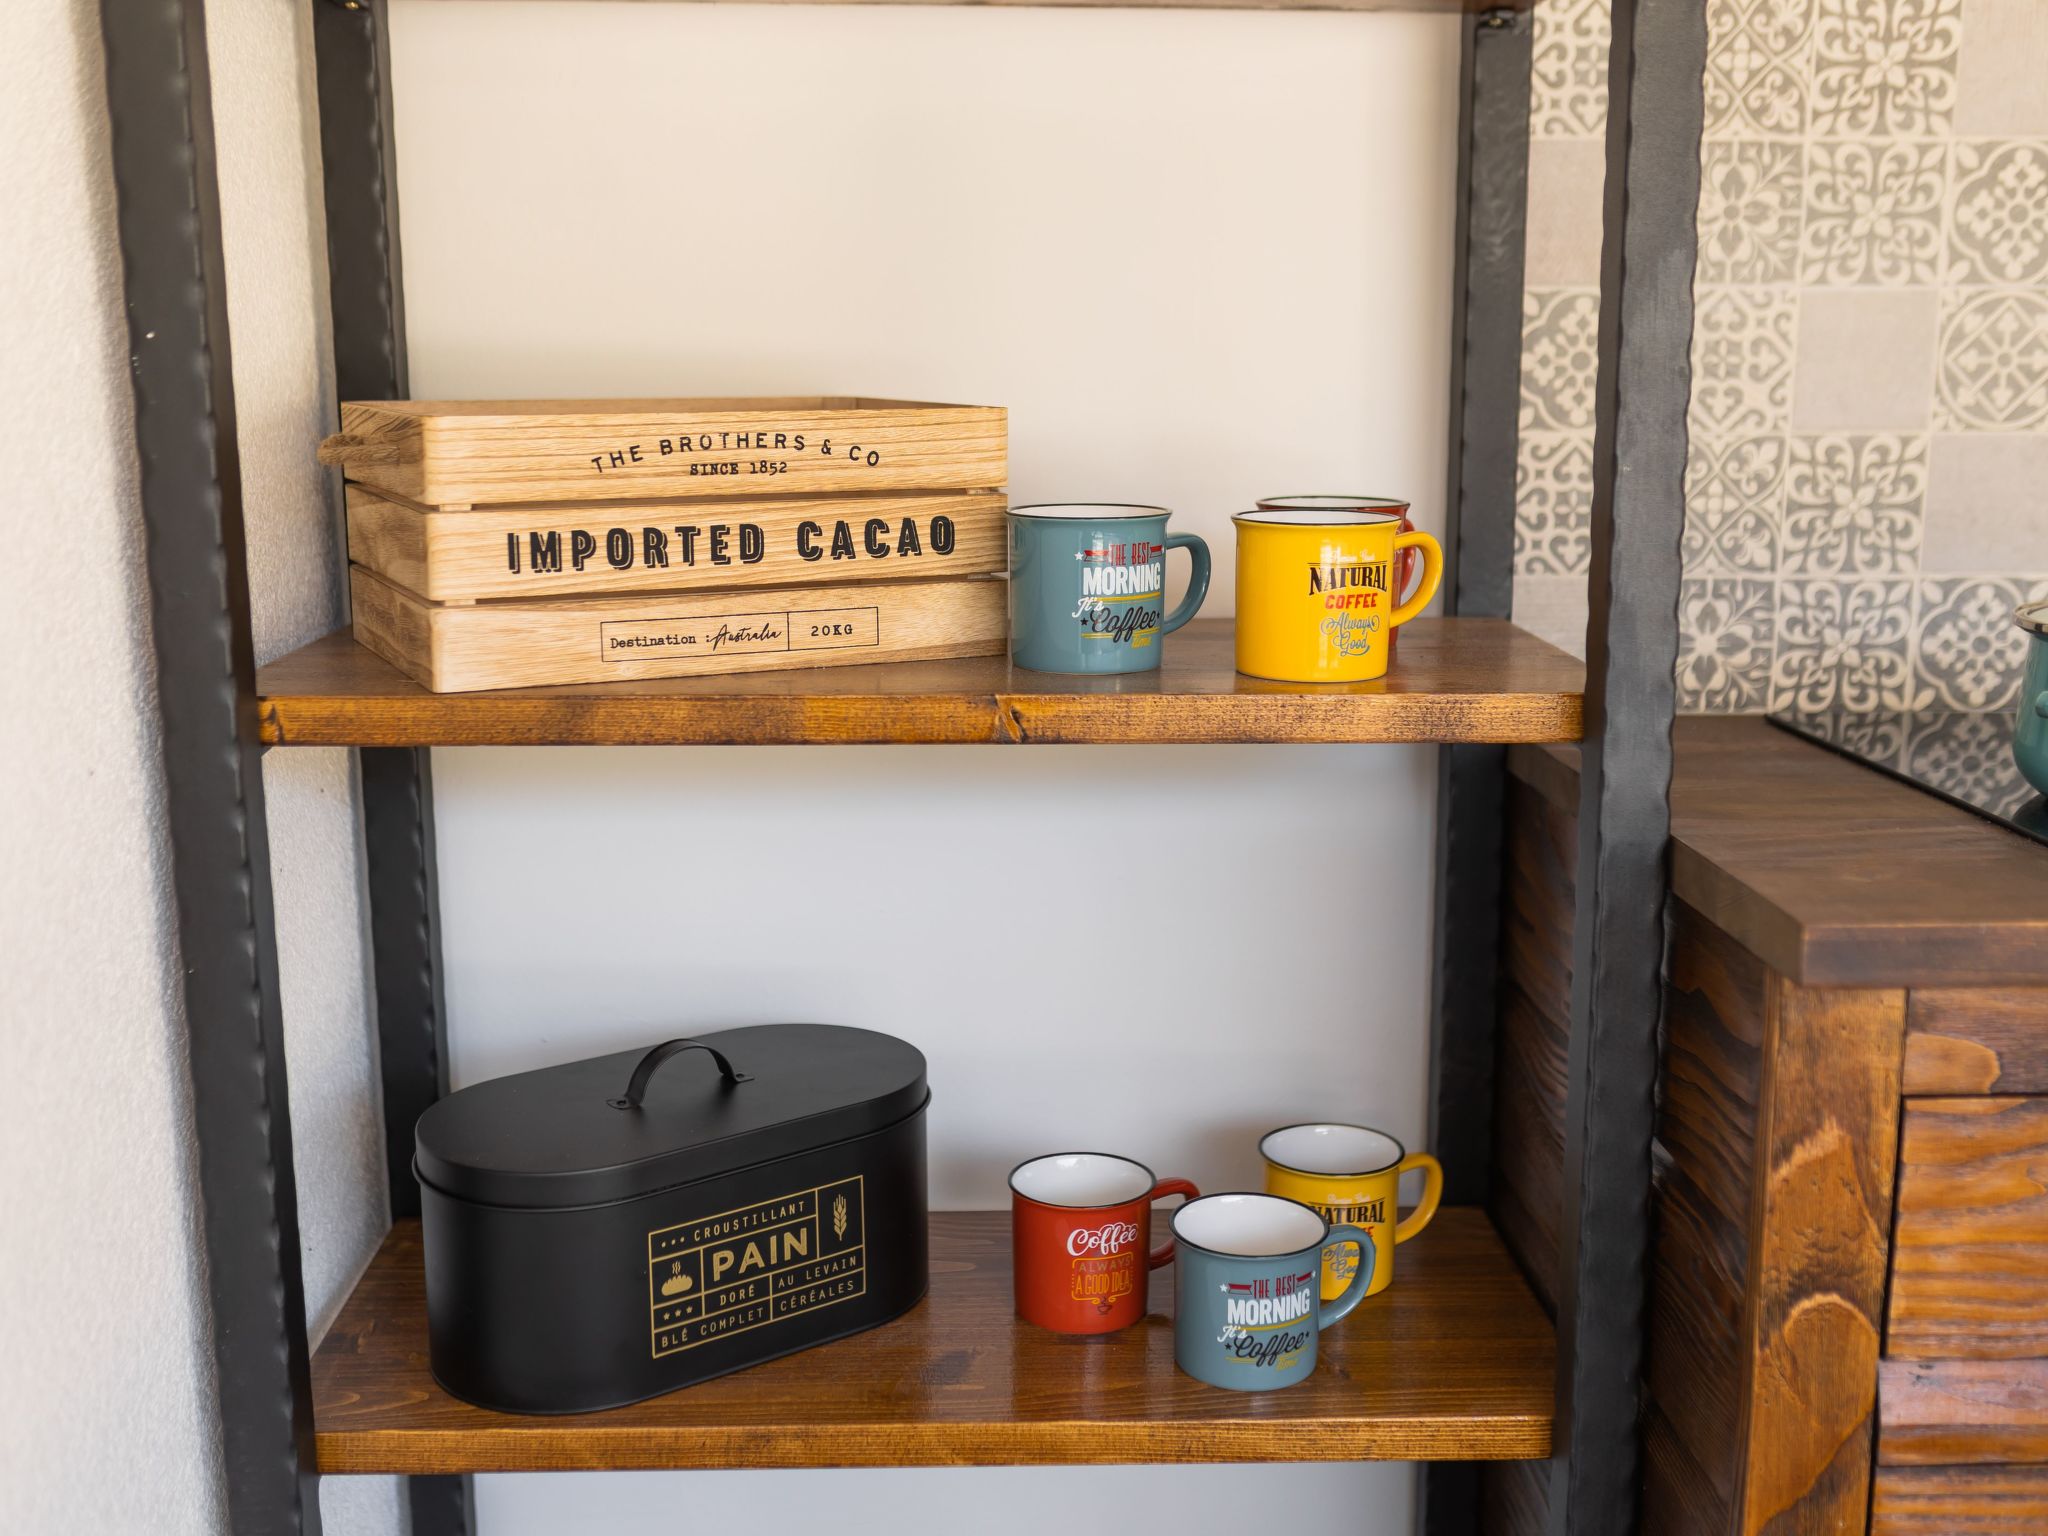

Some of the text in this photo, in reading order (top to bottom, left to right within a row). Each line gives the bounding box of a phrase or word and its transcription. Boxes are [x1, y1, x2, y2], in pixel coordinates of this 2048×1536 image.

[591, 432, 880, 474] THE BROTHERS & CO
[690, 461, 787, 476] SINCE 1852
[507, 515, 956, 574] IMPORTED CACAO
[1110, 542, 1150, 566] THE BEST
[1083, 562, 1161, 595] MORNING
[1309, 565, 1387, 596] NATURAL
[1071, 596, 1105, 618] It's
[1325, 592, 1378, 609] COFFEE
[610, 634, 697, 649] Destination
[710, 623, 782, 651] Australia
[810, 624, 853, 637] 20KG
[1089, 606, 1157, 643] Coffee
[1321, 612, 1380, 636] Always
[1333, 631, 1370, 657] Good
[694, 1201, 805, 1242] CROUSTILLANT
[1066, 1221, 1139, 1256] Coffee
[712, 1227, 808, 1282] PAIN
[1079, 1257, 1131, 1272] ALWAYS
[778, 1255, 857, 1289] AU LEVAIN
[1075, 1275, 1082, 1295] A
[1084, 1273, 1110, 1295] GOOD
[1253, 1273, 1297, 1299] THE BEST
[719, 1284, 755, 1306] DORÉ
[780, 1280, 854, 1311] CÉRÉALES
[1227, 1288, 1310, 1326] MORNING
[661, 1307, 764, 1348] BLÉ COMPLET
[1217, 1324, 1248, 1342] It's
[1233, 1331, 1304, 1367] Coffee
